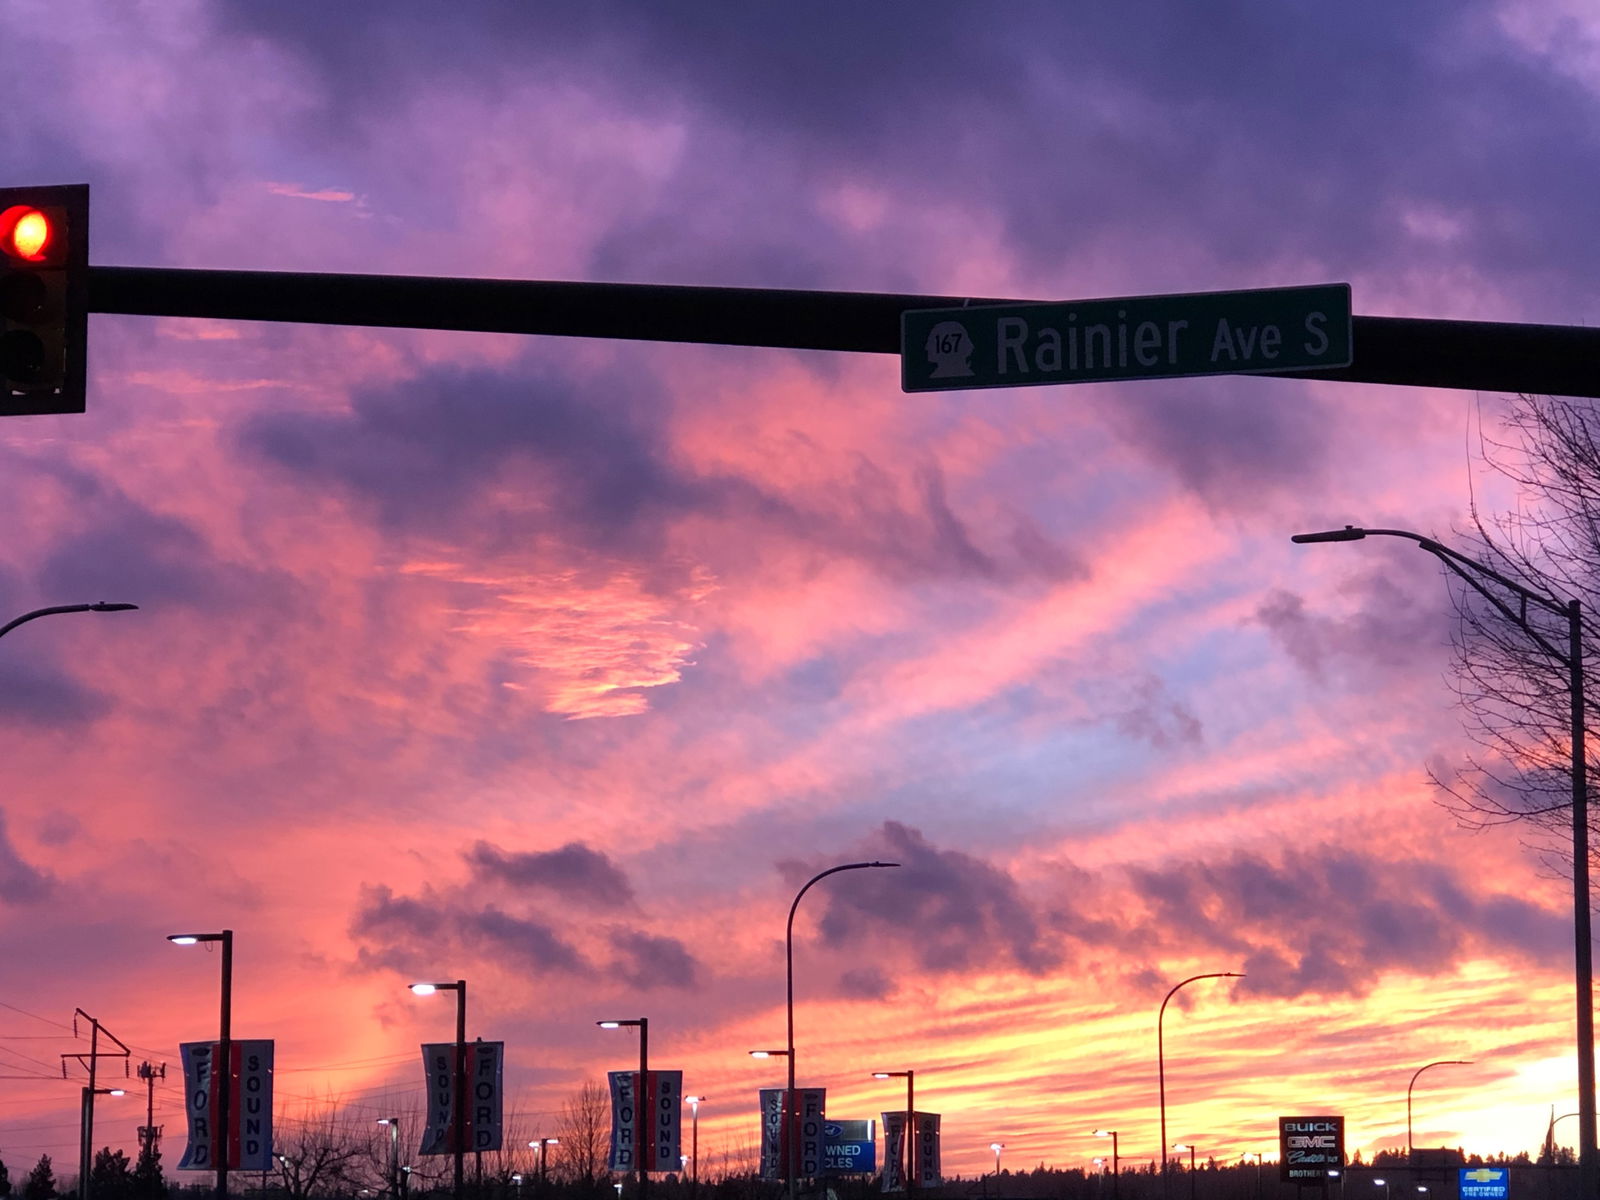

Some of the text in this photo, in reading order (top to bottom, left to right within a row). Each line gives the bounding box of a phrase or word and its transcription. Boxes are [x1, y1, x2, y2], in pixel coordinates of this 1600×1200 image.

[934, 332, 962, 355] 167
[997, 310, 1329, 375] Rainier Ave S
[193, 1062, 209, 1164] FORD
[246, 1055, 260, 1155] SOUND
[436, 1056, 449, 1141] SOUND
[476, 1059, 493, 1148] FORD
[619, 1086, 633, 1164] FORD
[660, 1081, 671, 1158] SOUND
[1284, 1122, 1337, 1132] BUICK
[804, 1104, 817, 1174] FORD
[825, 1145, 861, 1156] WNED
[825, 1157, 854, 1168] CLES
[923, 1120, 934, 1180] SOUND
[1287, 1135, 1336, 1148] GMC
